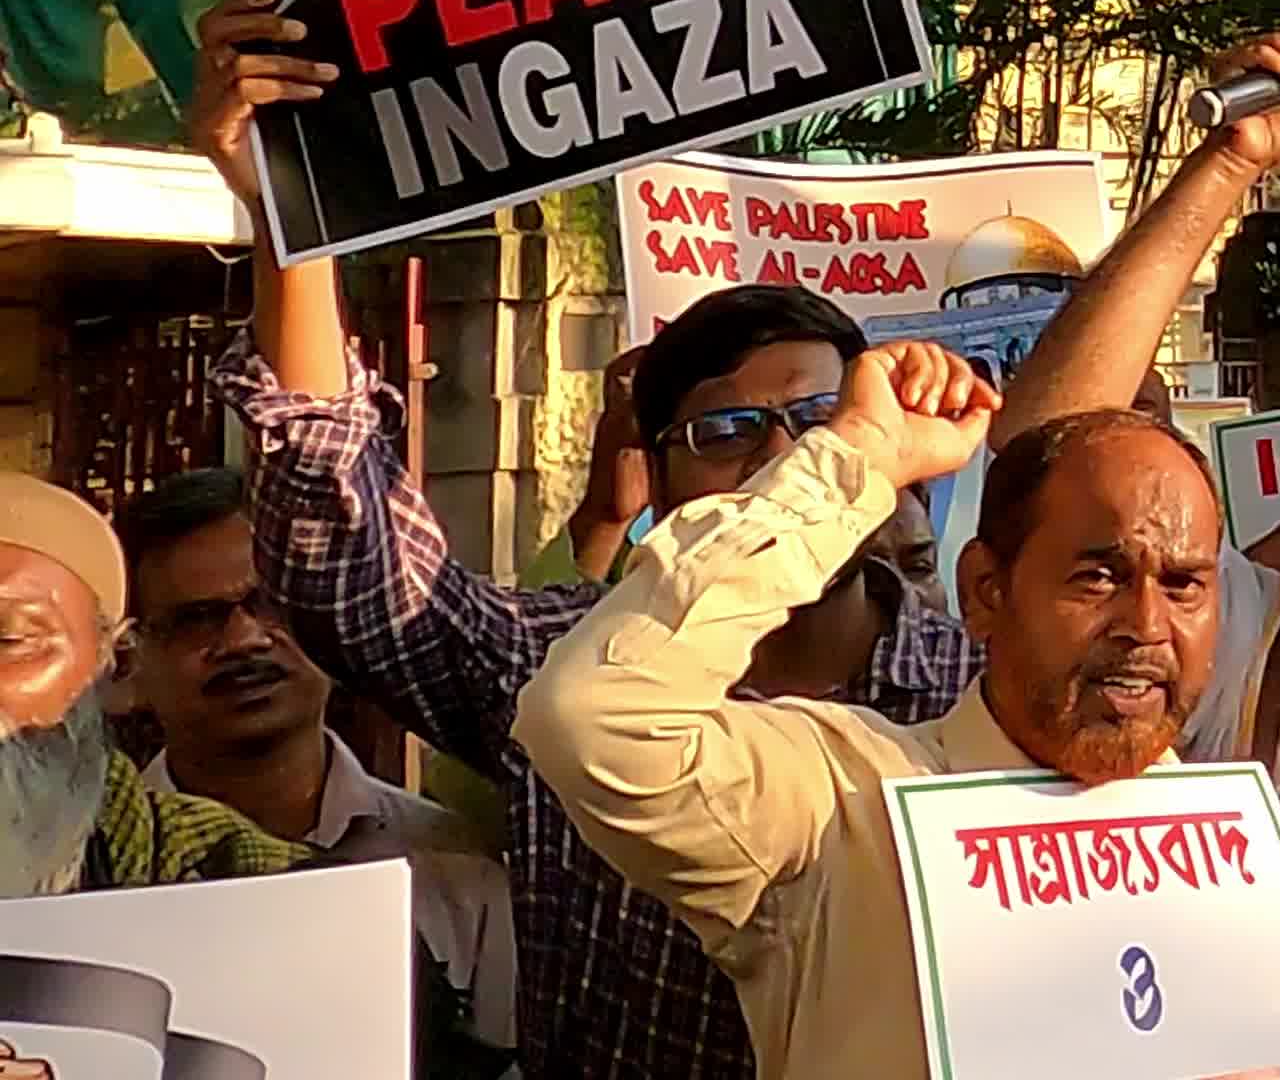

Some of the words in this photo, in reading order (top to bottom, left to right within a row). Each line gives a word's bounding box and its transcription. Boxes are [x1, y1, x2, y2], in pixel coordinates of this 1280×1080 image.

[371, 62, 510, 200] IN
[638, 180, 732, 231] SAVE
[746, 197, 930, 245] PALESTINE
[646, 230, 742, 282] SAVE
[756, 249, 927, 295] AL-AQSA
[955, 810, 1256, 912] সাম্রাজ্যবাদ
[1120, 946, 1164, 1032] ও
